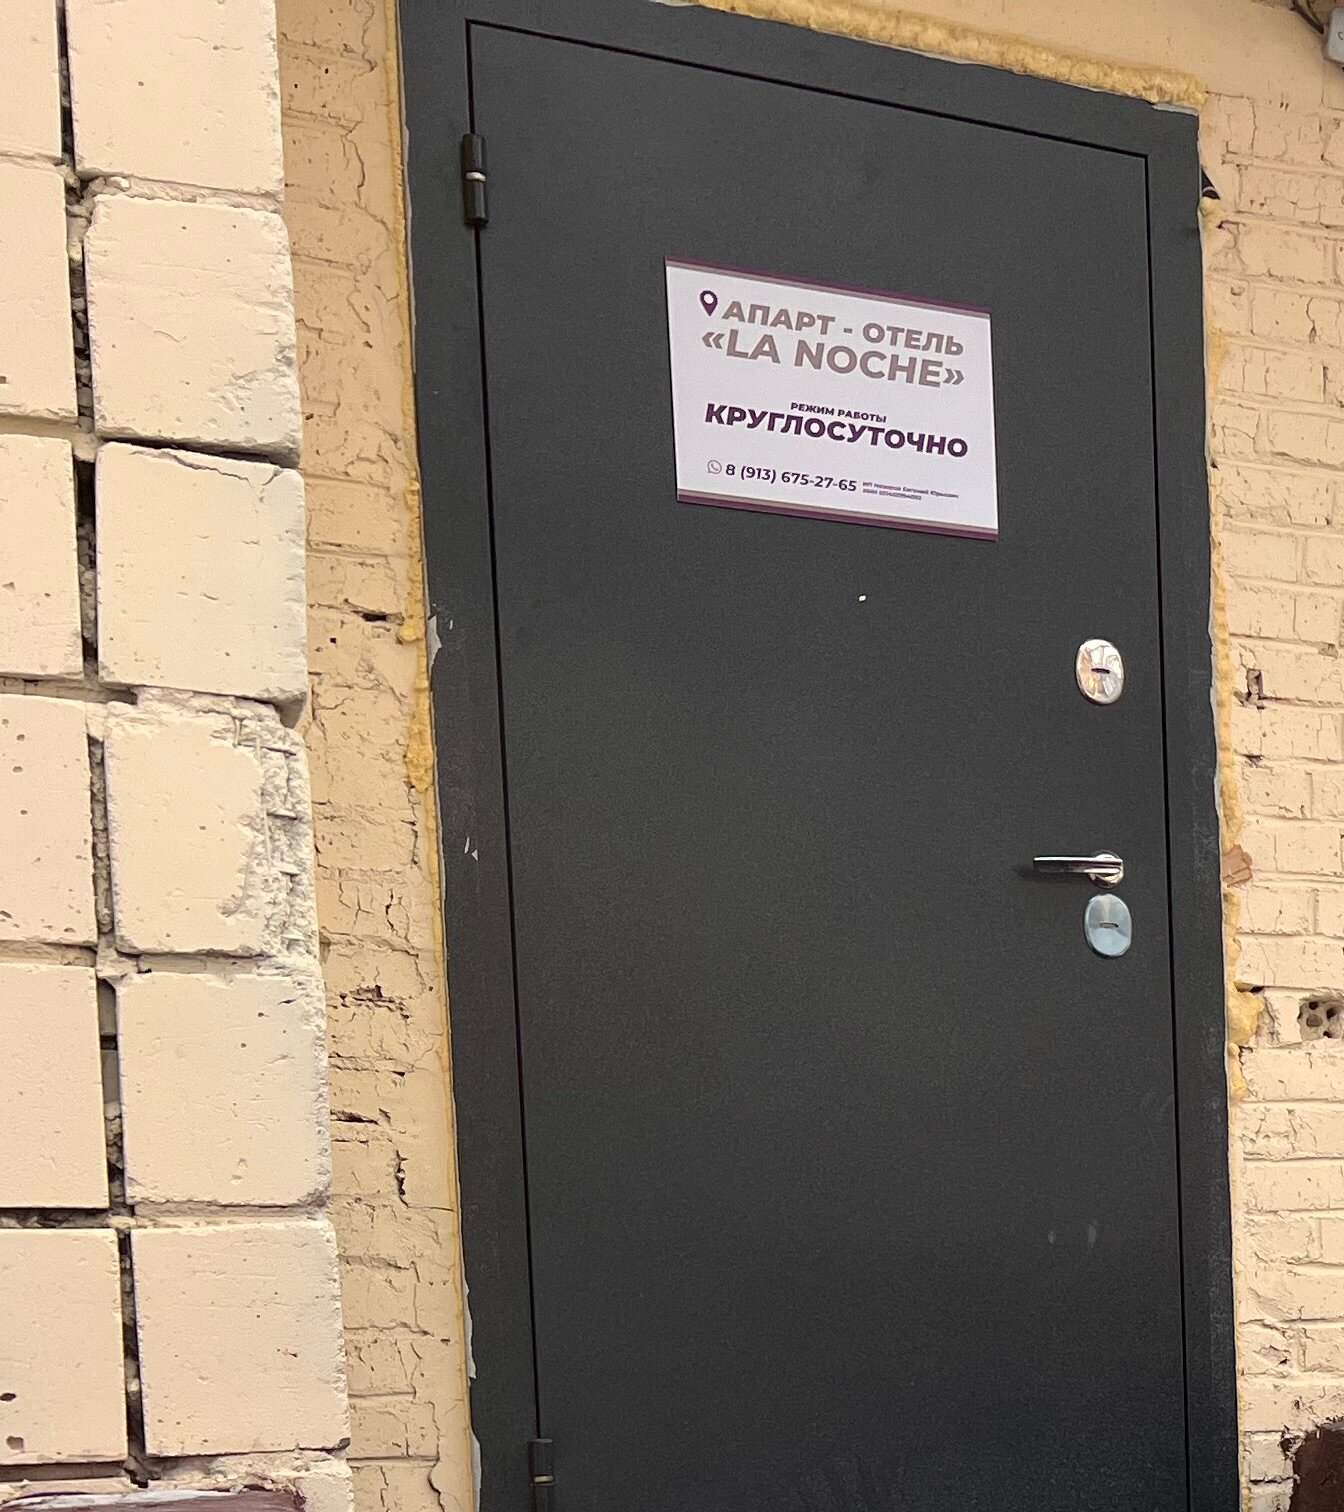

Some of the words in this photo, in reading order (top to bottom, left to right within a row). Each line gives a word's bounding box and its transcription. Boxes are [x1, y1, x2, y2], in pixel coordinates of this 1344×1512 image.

[722, 300, 836, 336] АПАРТ
[862, 322, 964, 356] ОТЕЛЬ
[701, 329, 780, 364] «LA
[795, 341, 965, 388] NOCHE»
[704, 403, 969, 459] КРУГЛОСУТОЧНО
[790, 402, 835, 417] РЕЖИМ
[837, 408, 887, 423] РАБОТЫ
[725, 464, 736, 477] 8
[740, 465, 777, 485] (913)
[781, 470, 857, 492] 675-27-65
